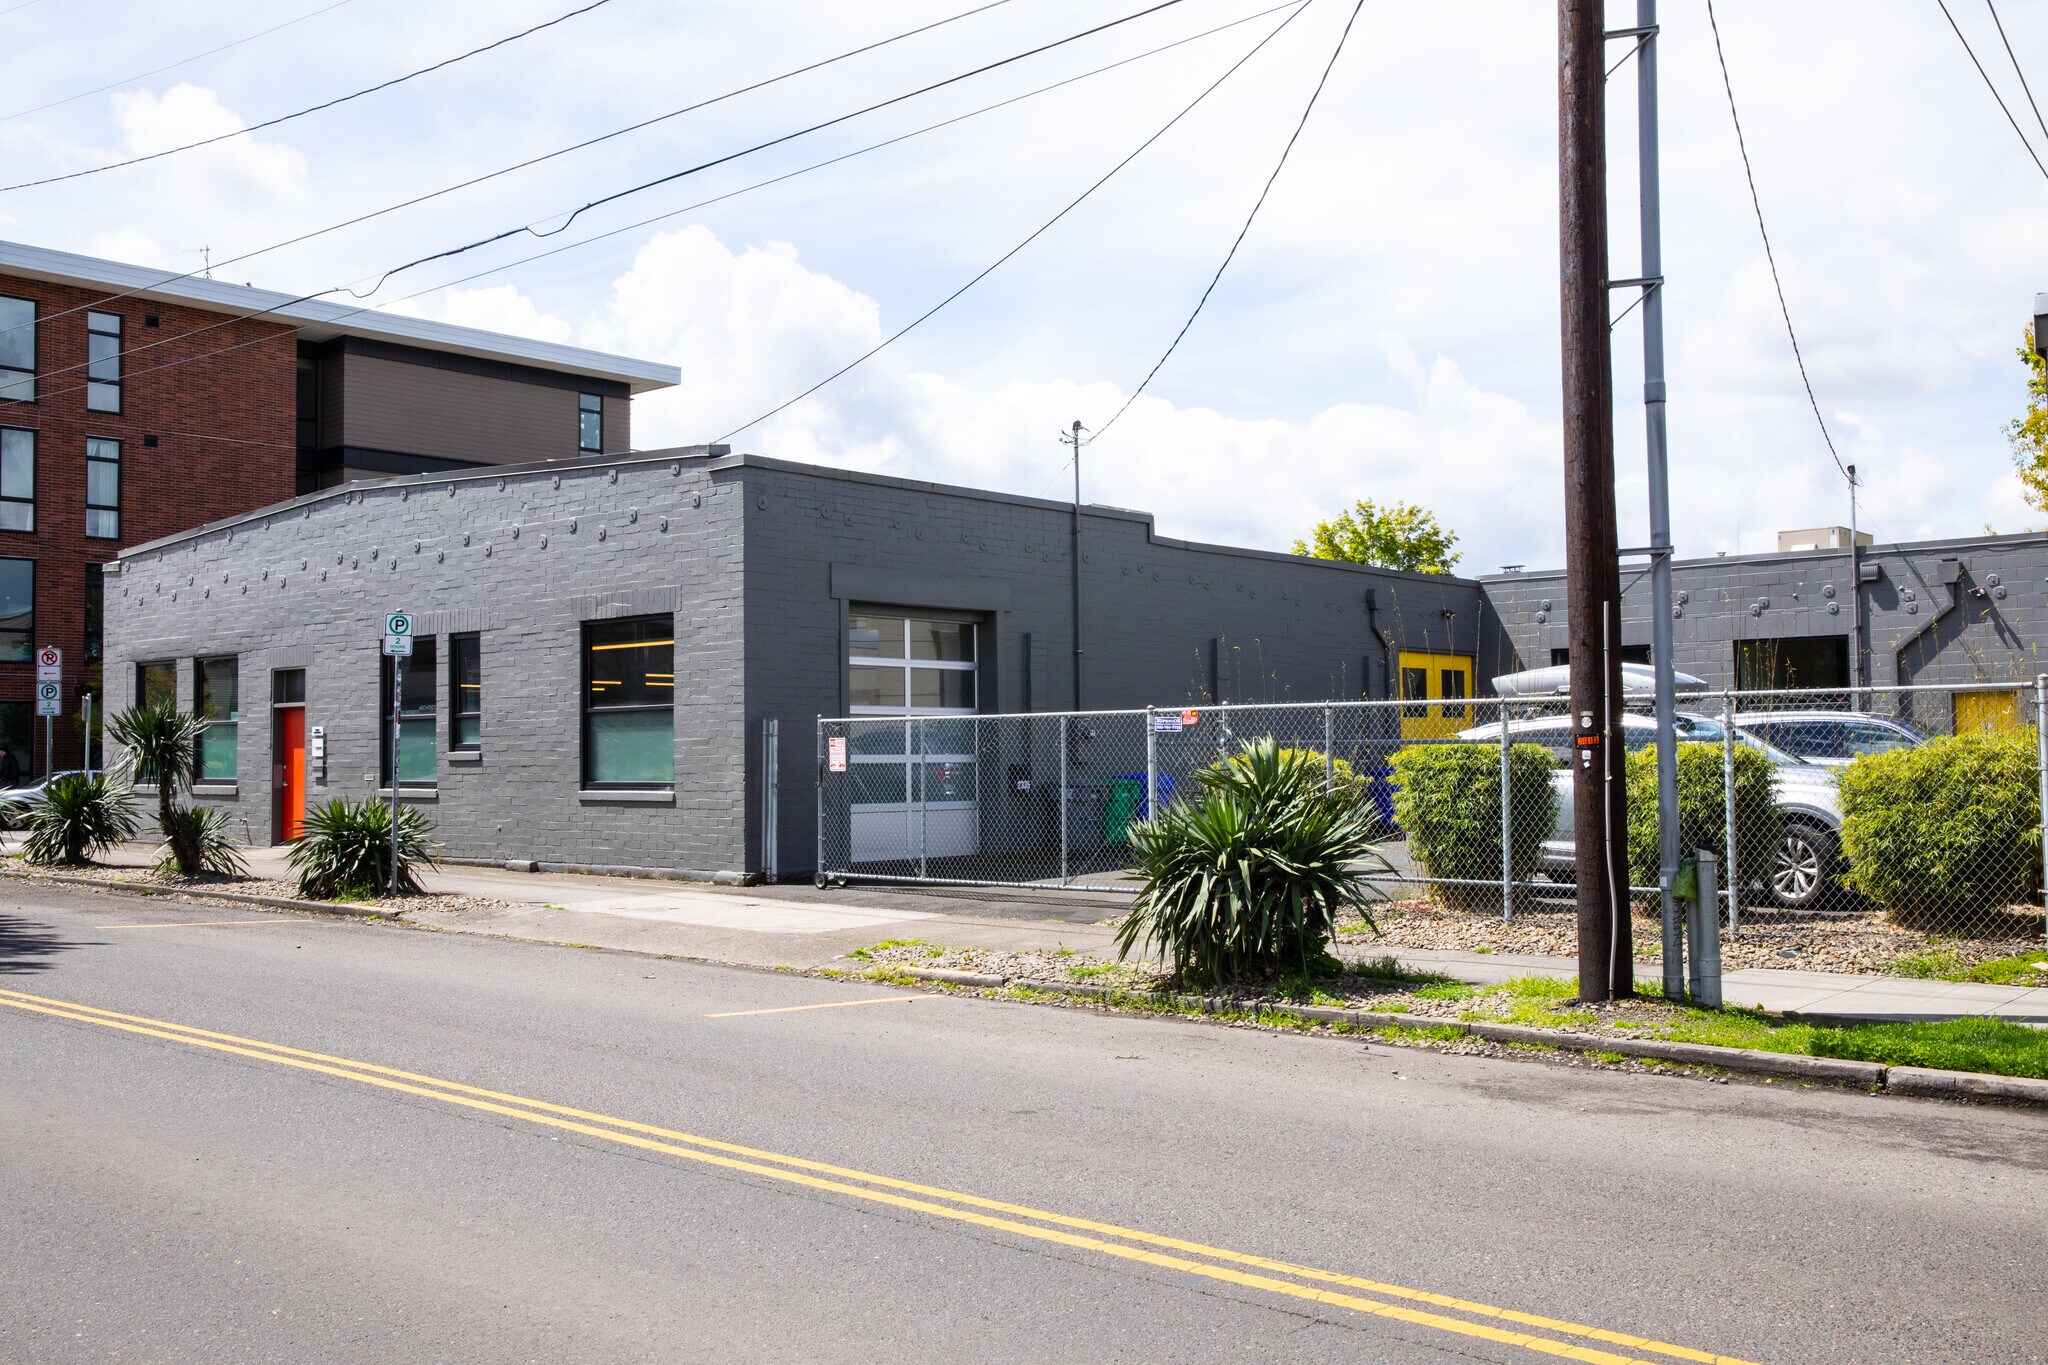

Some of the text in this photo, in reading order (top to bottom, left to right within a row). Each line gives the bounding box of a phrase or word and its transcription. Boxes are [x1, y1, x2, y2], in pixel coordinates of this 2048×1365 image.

[395, 619, 405, 631] P
[395, 637, 401, 645] 2
[46, 687, 54, 697] P
